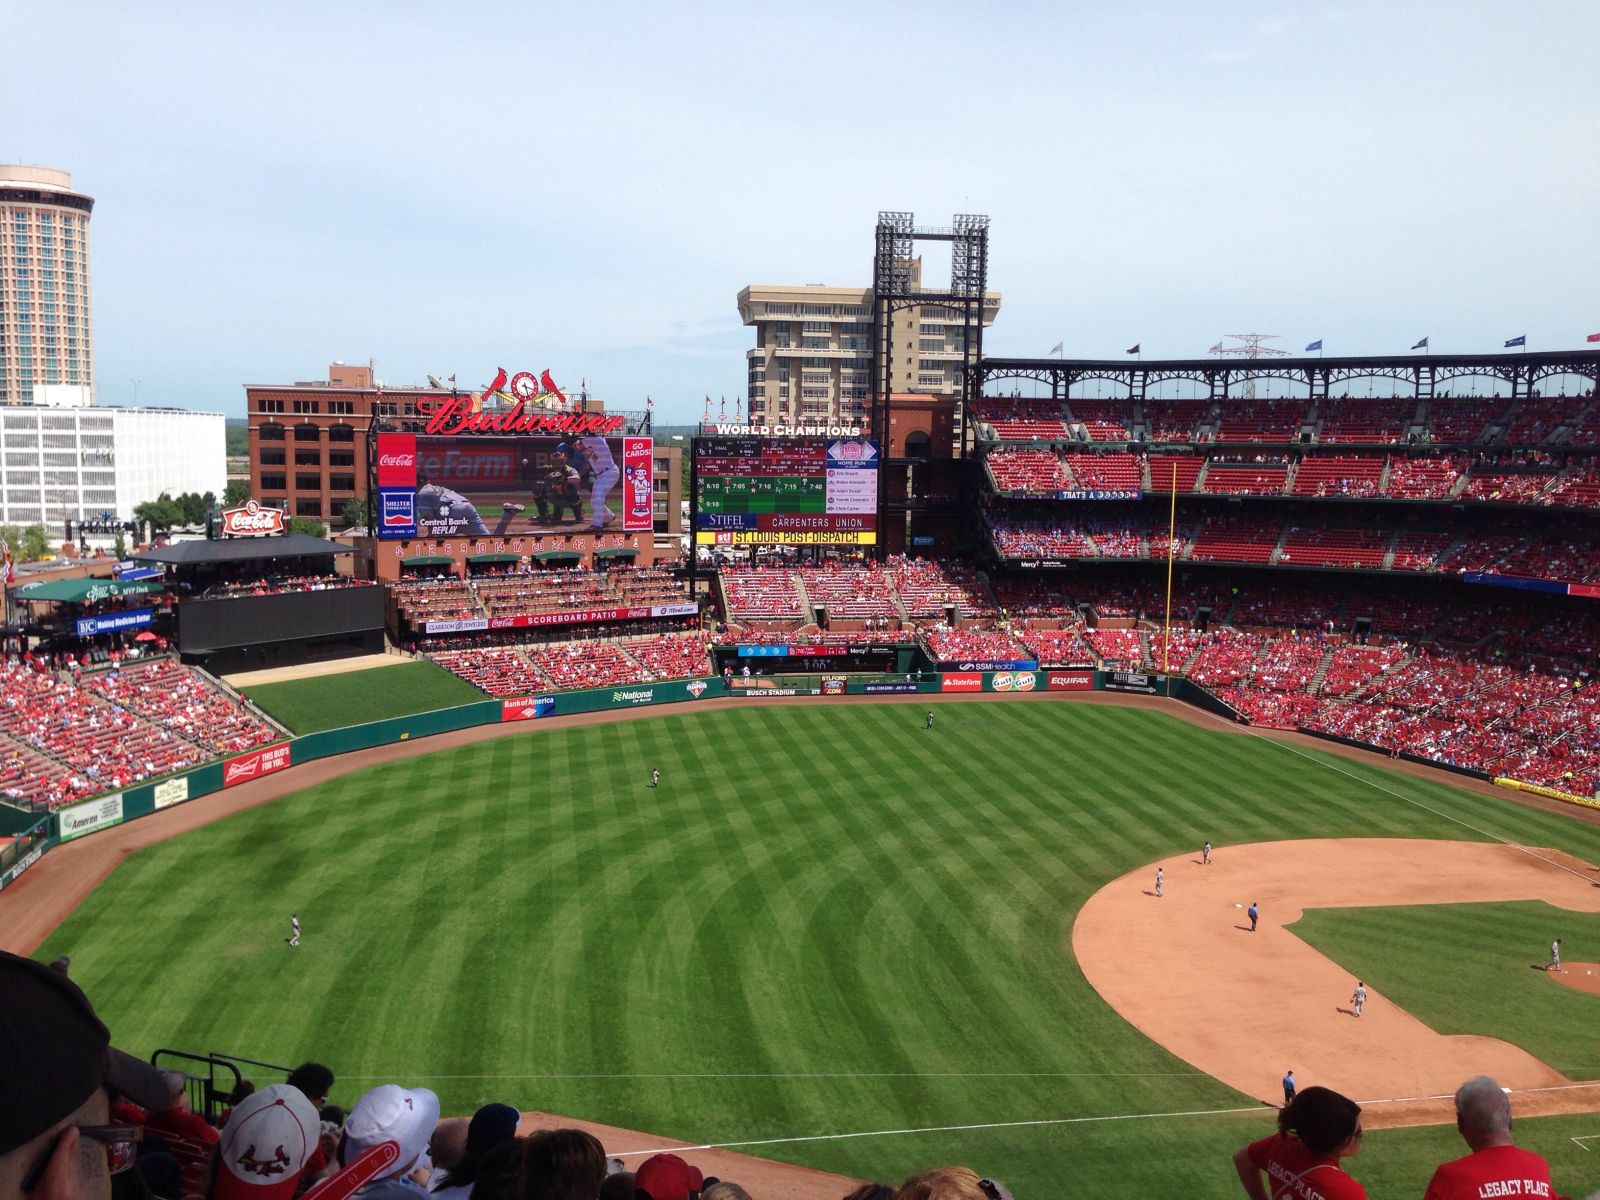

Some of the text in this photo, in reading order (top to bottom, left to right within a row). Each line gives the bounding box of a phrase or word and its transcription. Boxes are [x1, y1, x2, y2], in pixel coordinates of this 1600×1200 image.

[416, 397, 624, 435] Budweiser
[717, 424, 861, 436] WORLD CHAMPIONS
[380, 454, 414, 467] Coca-Cola
[230, 512, 276, 530] Coca-Cola
[420, 516, 468, 526] Central Bank
[710, 513, 744, 526] STIFEL
[772, 518, 862, 527] CARPENTERS UNION
[432, 526, 458, 535] REPLAY
[736, 532, 858, 542] ST. LOUIS POST-DISPATCH
[416, 544, 420, 556] 1
[428, 544, 436, 556] 2
[444, 544, 452, 556] 6
[460, 543, 468, 554] 9
[476, 542, 486, 554] 10
[495, 542, 504, 552] 14
[513, 541, 524, 552] 17
[552, 540, 565, 552] 24
[572, 538, 586, 550] 42
[98, 620, 114, 630] Making
[115, 617, 136, 626] Medicine
[491, 618, 514, 628] Coca-Cola
[527, 612, 588, 624] SCOREBOARD
[592, 611, 617, 620] PATIO
[80, 621, 94, 634] BJC
[993, 678, 1012, 687] Gulf
[1016, 677, 1034, 687] Gulf
[1051, 677, 1089, 686] EQUIFAX
[528, 697, 554, 705] America
[622, 689, 653, 700] National
[262, 746, 290, 761] THIS BUD'S
[262, 758, 285, 772] FOR YOU.
[72, 814, 98, 830] Ameren
[1478, 1179, 1550, 1199] LEGACY PLACE
